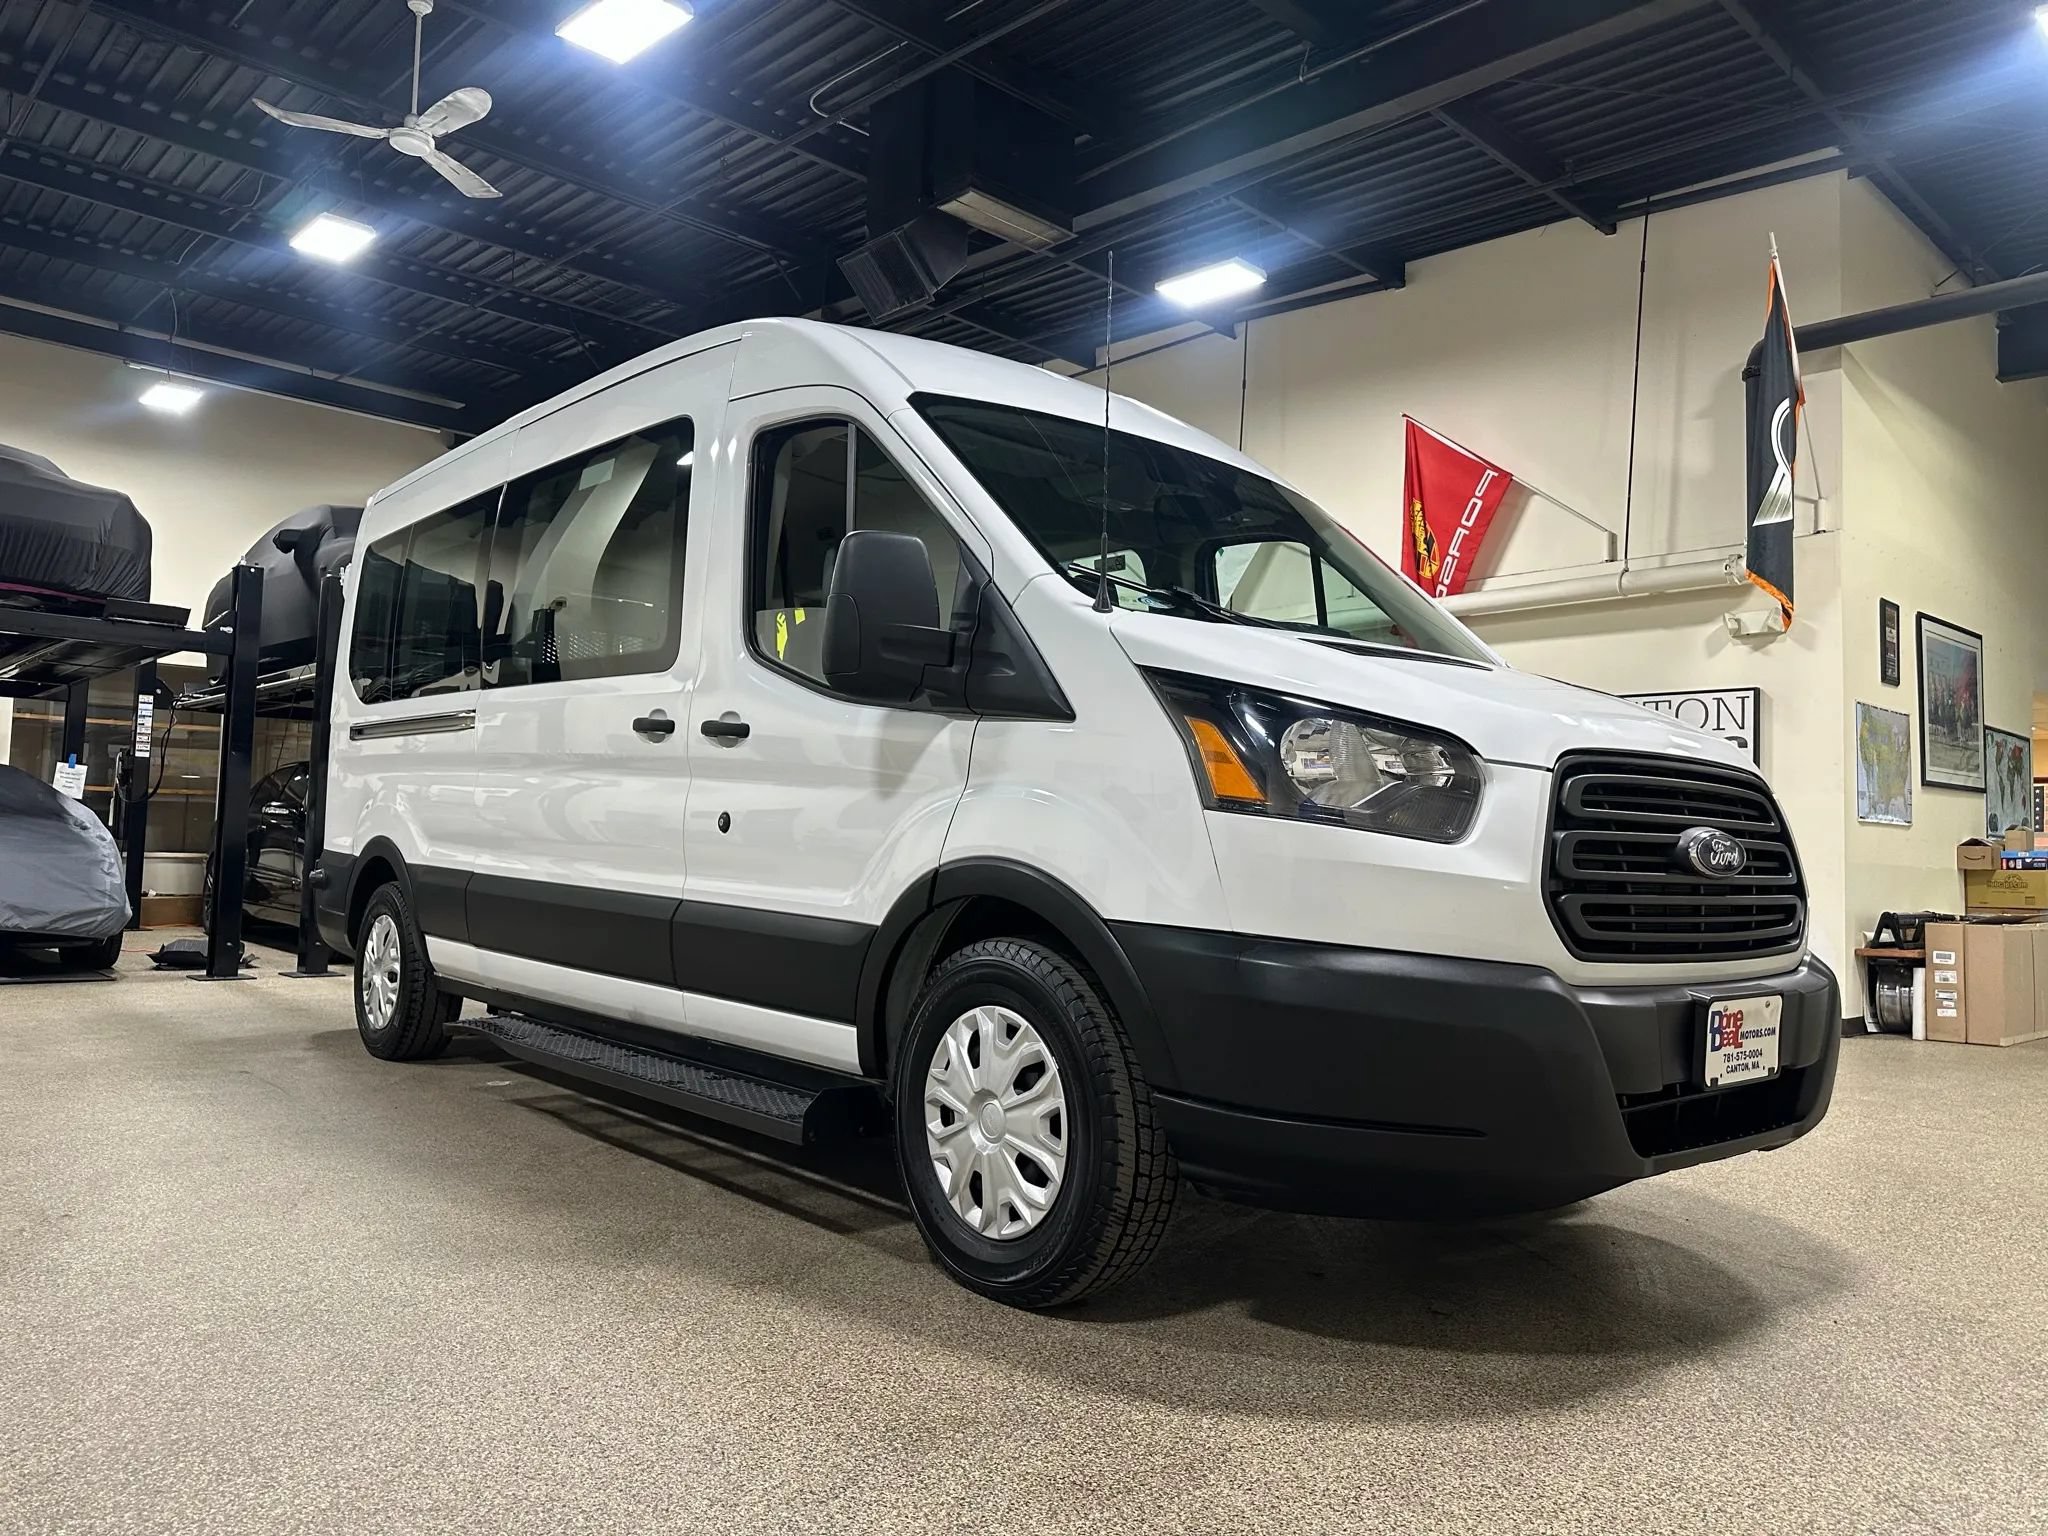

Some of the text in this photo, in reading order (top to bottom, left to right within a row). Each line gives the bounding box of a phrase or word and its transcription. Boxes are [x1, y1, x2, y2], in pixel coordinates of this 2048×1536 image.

[1635, 695, 1750, 731] TON
[1710, 839, 1739, 866] Ford
[1709, 1010, 1743, 1033] Done
[1740, 1027, 1776, 1040] MOTORS.COM
[1723, 1048, 1763, 1063] 781-575-0004
[1726, 1060, 1760, 1074] CANTON, MA
